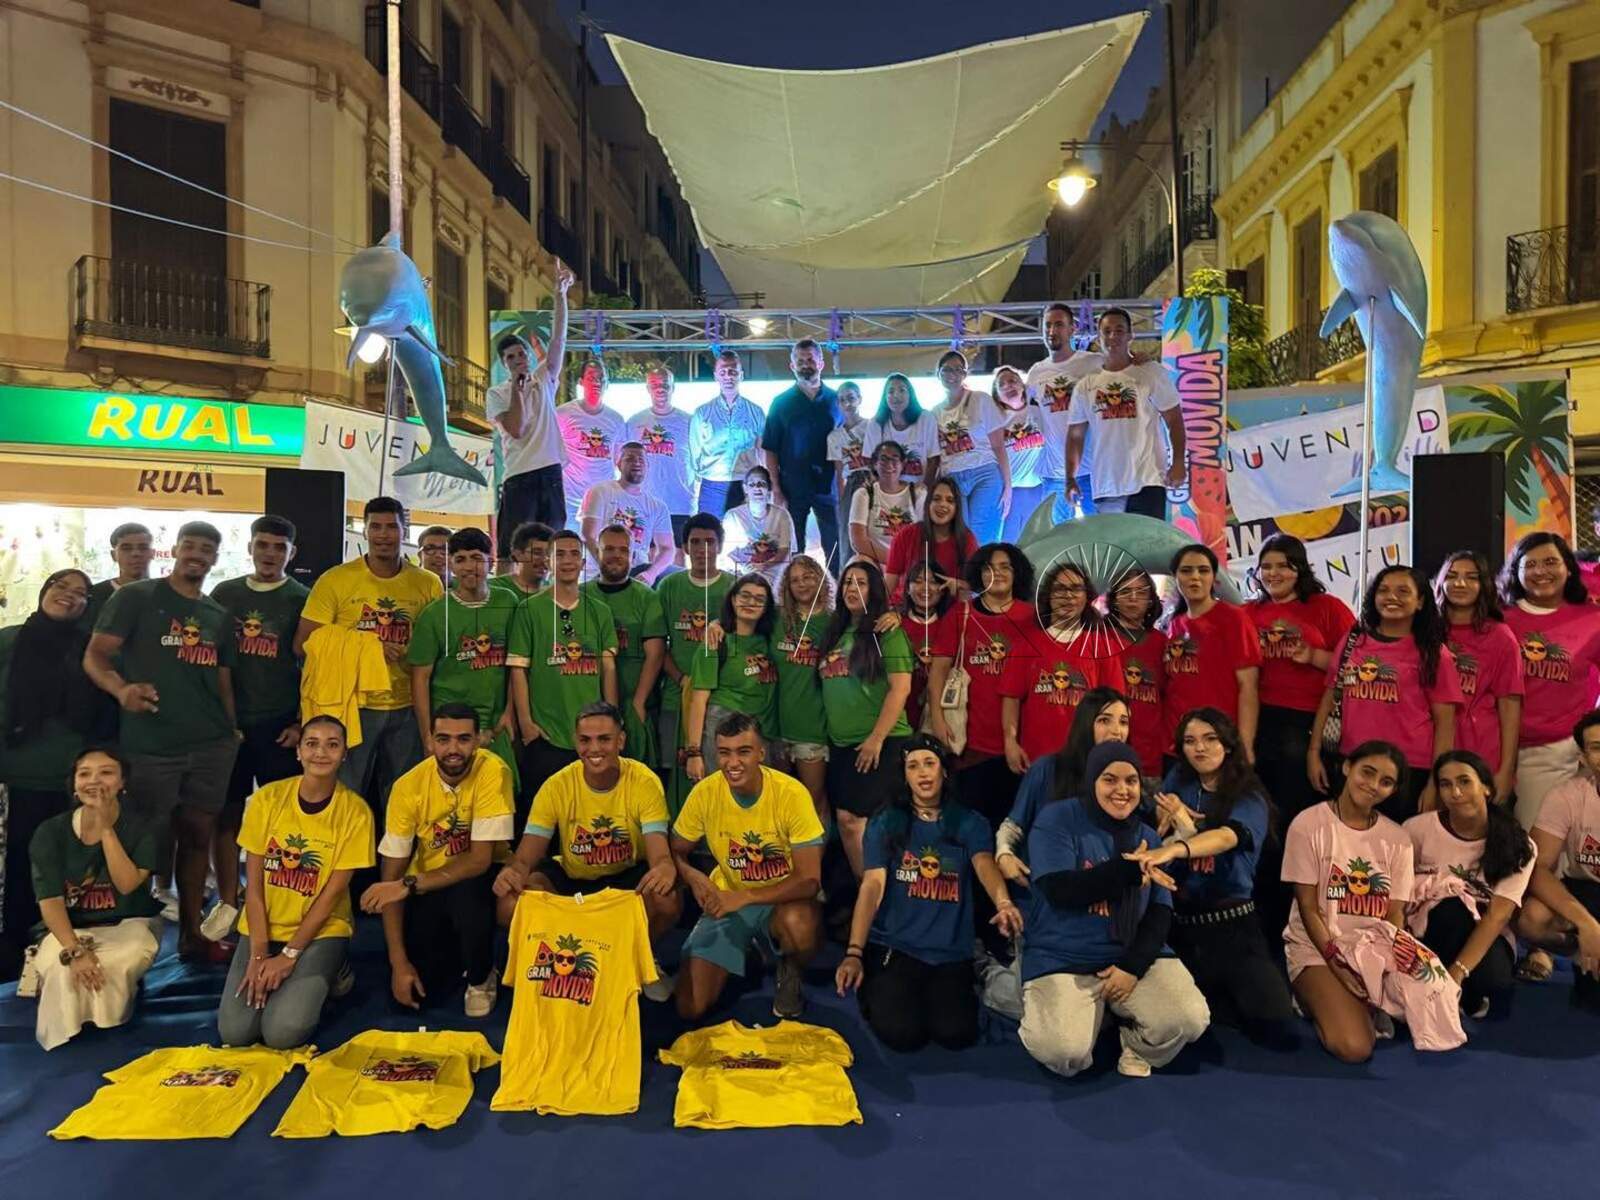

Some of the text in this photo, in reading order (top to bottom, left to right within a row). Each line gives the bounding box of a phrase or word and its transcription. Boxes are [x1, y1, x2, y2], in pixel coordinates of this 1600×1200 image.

[87, 396, 274, 446] RUAL
[1176, 349, 1223, 471] MOVIDA
[1226, 408, 1440, 473] JUVEND
[138, 469, 224, 496] RUAL
[969, 654, 991, 665] GRAN
[1348, 680, 1399, 703] MOVIDA
[268, 867, 318, 896] MOVIDA
[741, 859, 788, 882] MOVIDA
[896, 869, 919, 883] GRAN
[907, 877, 960, 902] MOVIDA
[1327, 885, 1347, 899] RAN
[527, 966, 552, 980] GRAN
[541, 974, 594, 1004] MOVIDA
